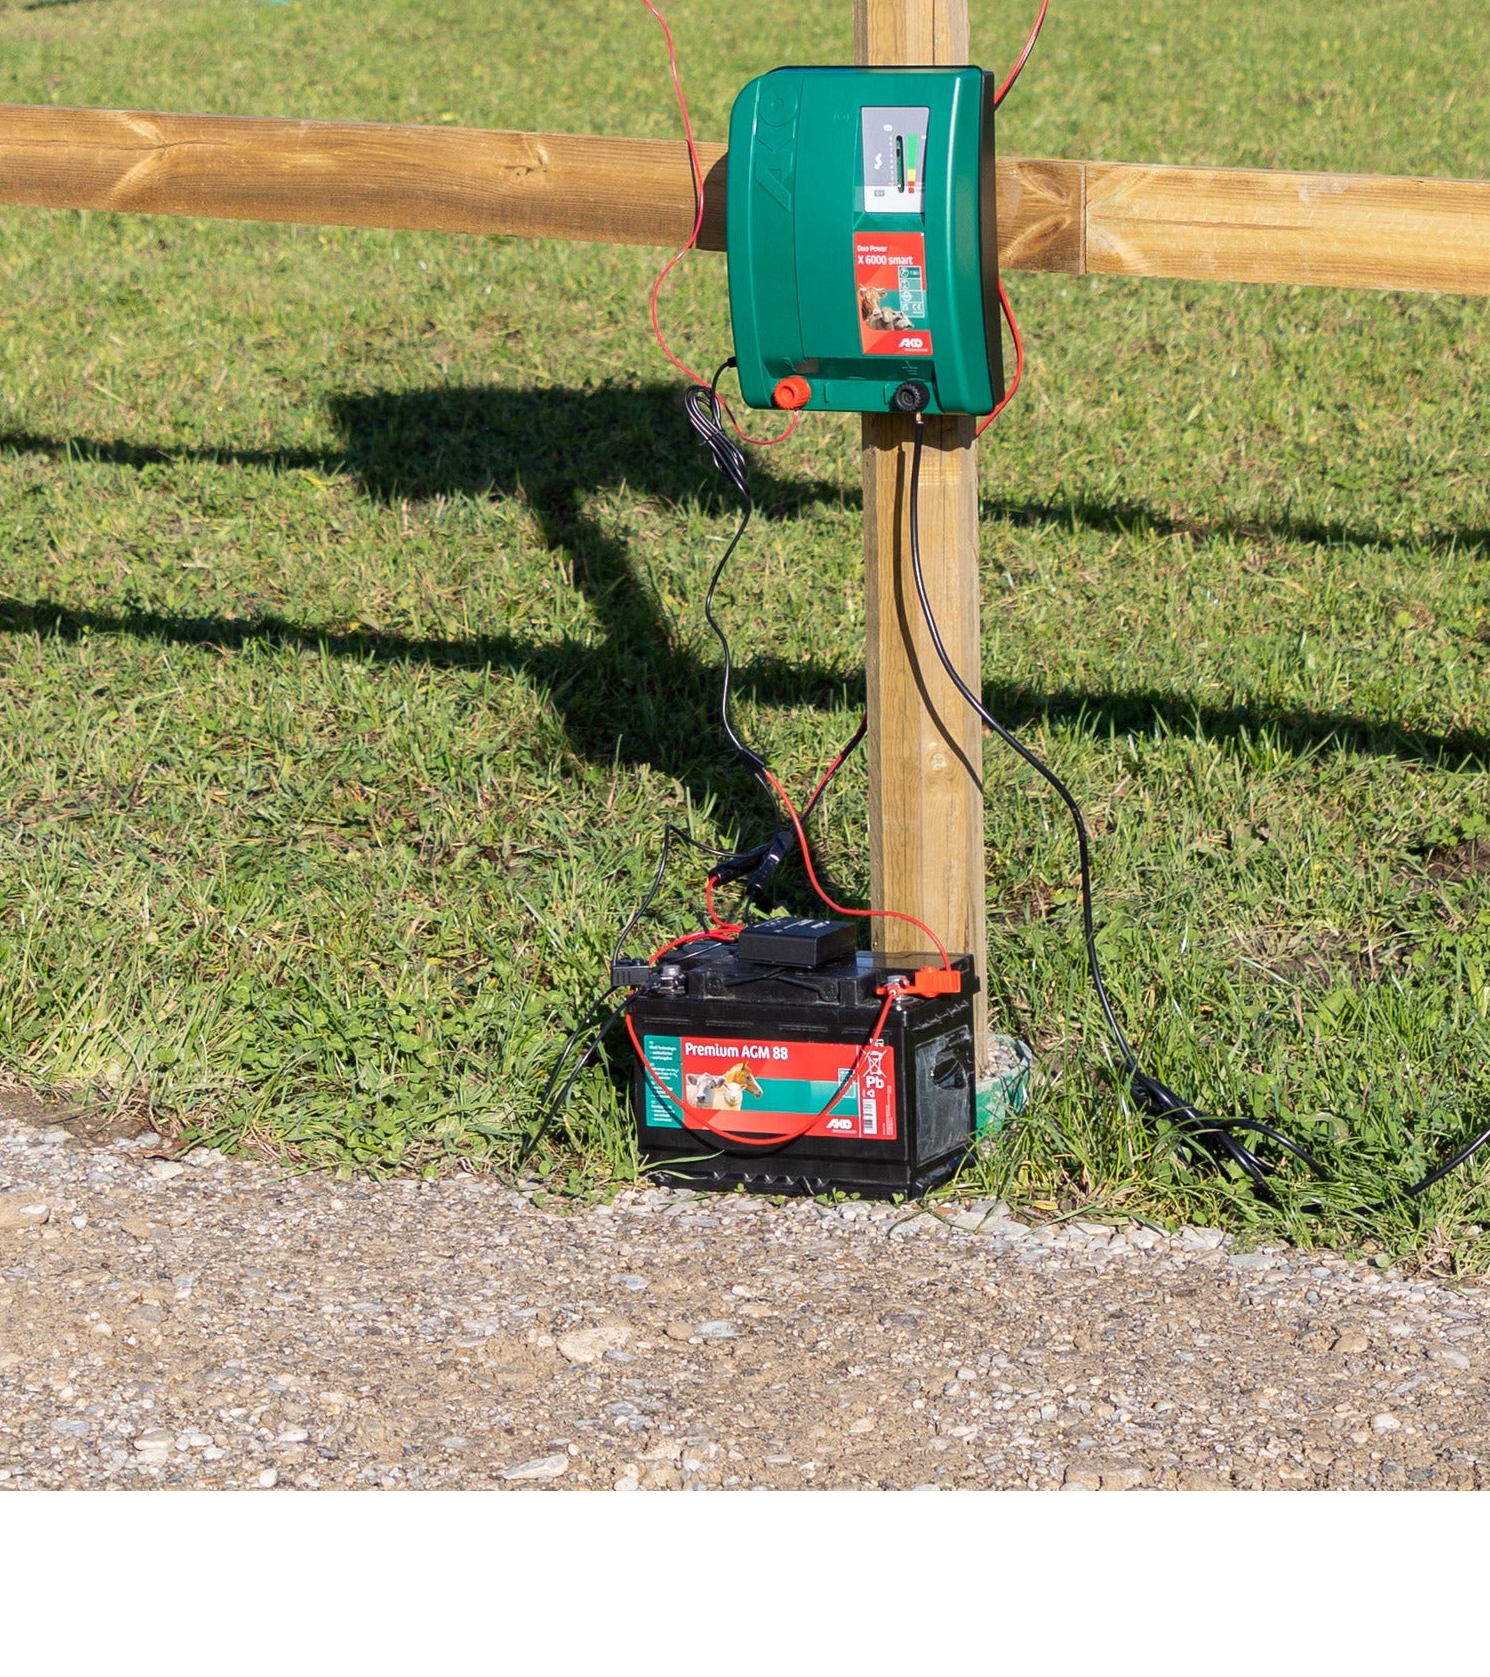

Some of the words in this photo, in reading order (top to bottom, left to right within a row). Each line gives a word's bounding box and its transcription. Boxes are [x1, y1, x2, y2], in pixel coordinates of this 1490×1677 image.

[755, 82, 798, 214] AKO
[857, 255, 864, 265] X
[865, 255, 887, 265] 6000
[888, 256, 913, 265] smart
[898, 338, 923, 348] AKO
[685, 1042, 739, 1058] Premium
[741, 1045, 770, 1060] AGM
[772, 1046, 789, 1060] 88
[865, 1075, 885, 1089] Pb
[826, 1118, 852, 1130] AKO
